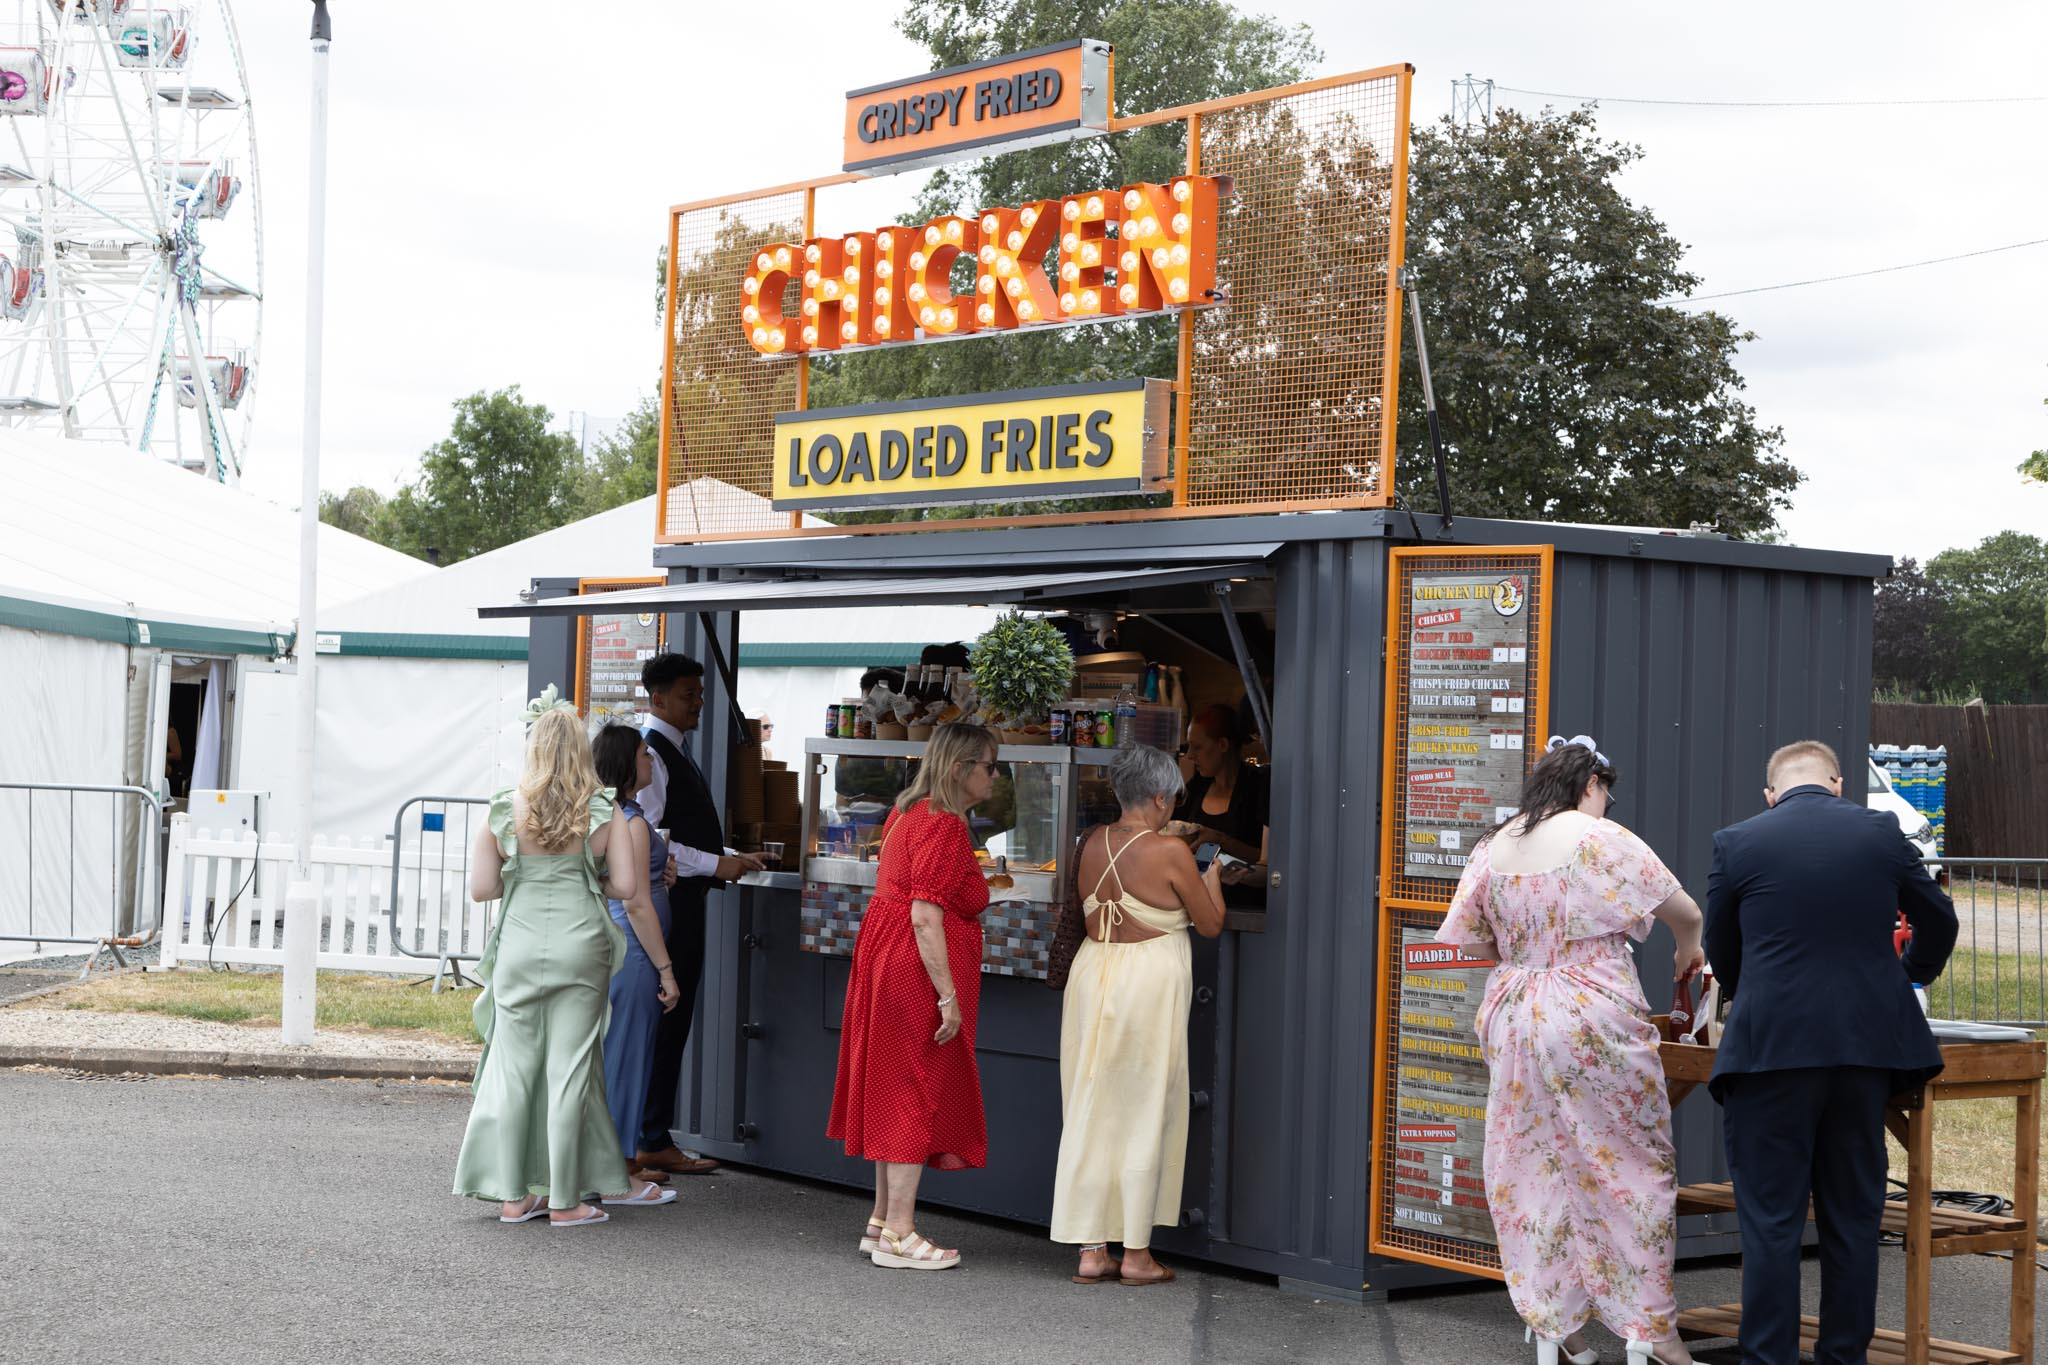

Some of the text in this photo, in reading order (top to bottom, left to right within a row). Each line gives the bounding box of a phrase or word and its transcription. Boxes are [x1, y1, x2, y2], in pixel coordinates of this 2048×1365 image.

[857, 67, 1062, 144] CRISPY FRIED
[741, 175, 1218, 355] CHICKEN
[788, 409, 1113, 488] LOADED FRIES
[1415, 585, 1500, 600] CHICKEN HUT
[1418, 612, 1455, 626] CHICKEN
[1413, 678, 1510, 690] CRISPY FRIED CHICKEN
[1412, 695, 1476, 706] FILLET BURGER
[1411, 725, 1470, 737] CRISPY FRIED
[1411, 741, 1478, 754] CHICKEN WINGS
[1411, 771, 1453, 782] COMBO MEAL
[1410, 832, 1437, 844] CHIPS
[1409, 853, 1469, 867] CHIPS & CHEE
[1408, 949, 1453, 963] LOADED
[1404, 975, 1432, 989] CHEESE
[1433, 1016, 1455, 1029] FRIES
[1449, 1043, 1469, 1057] PORK
[1431, 1070, 1453, 1083] FRIES
[1432, 1102, 1469, 1117] SEASONED
[1472, 1107, 1487, 1120] FRI
[1401, 1129, 1456, 1137] EXTRA TOPPINGS
[1395, 1207, 1443, 1225] SOFT DRINKS
